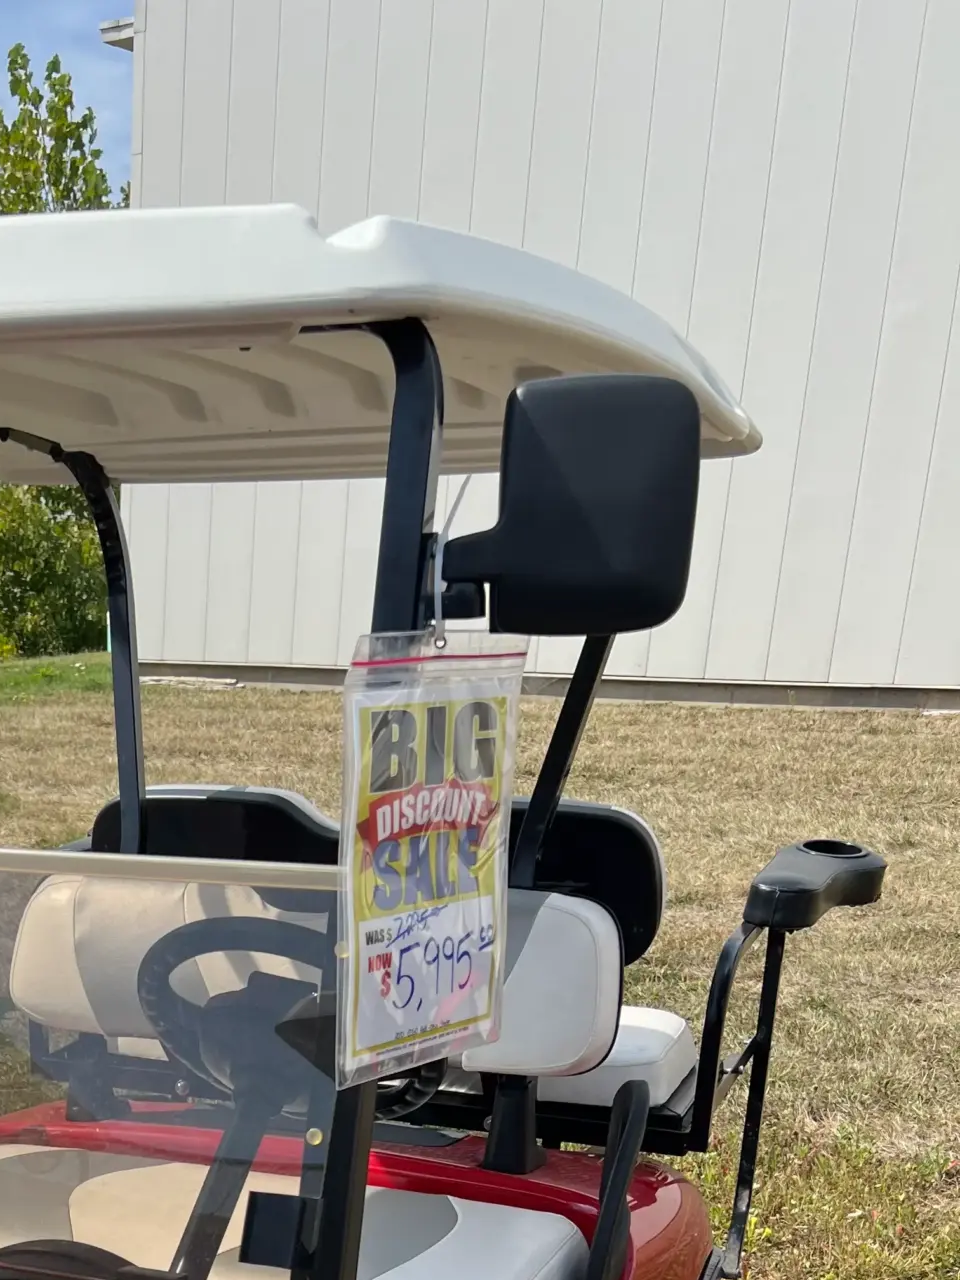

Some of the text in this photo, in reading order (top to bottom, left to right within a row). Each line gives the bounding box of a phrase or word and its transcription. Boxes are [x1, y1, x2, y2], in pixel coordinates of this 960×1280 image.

[370, 701, 498, 793] BIG
[376, 787, 486, 842] DISCOUNT
[373, 827, 480, 912] SALE
[368, 952, 392, 973] NOW
